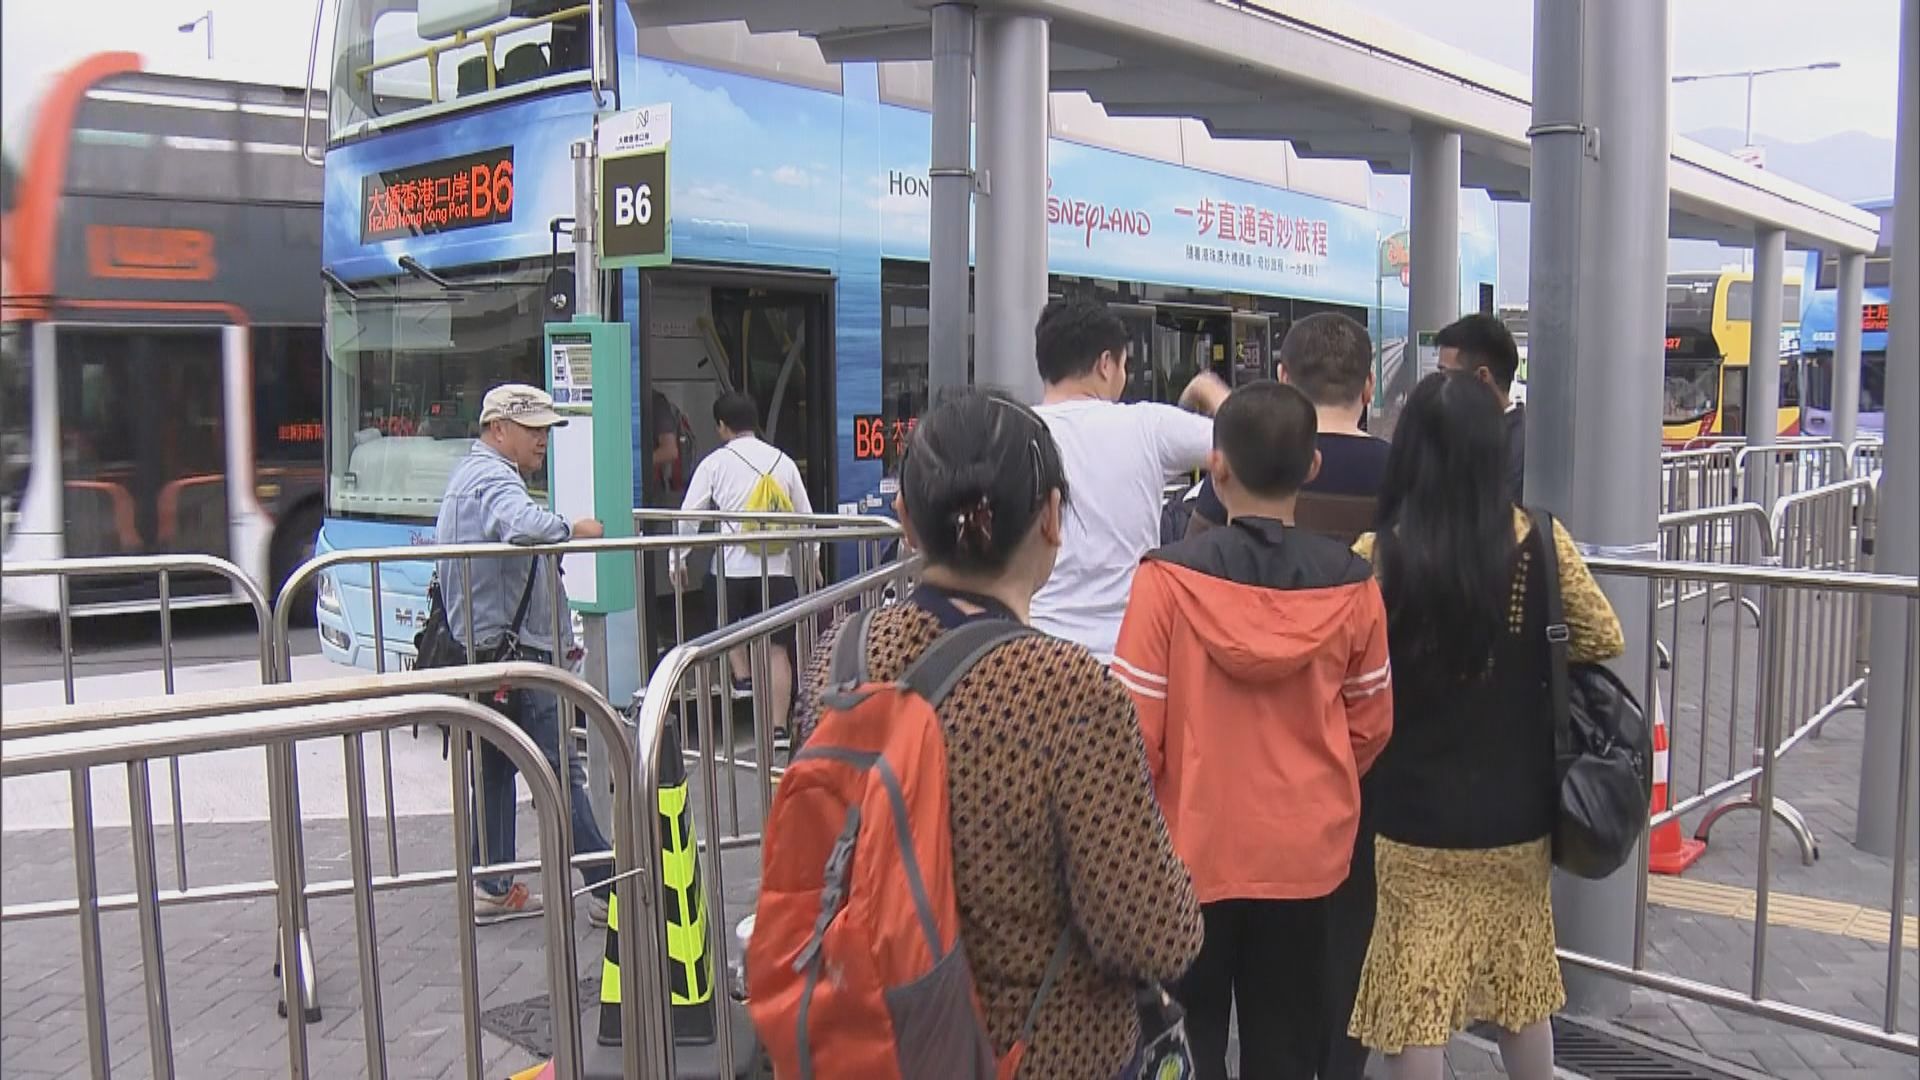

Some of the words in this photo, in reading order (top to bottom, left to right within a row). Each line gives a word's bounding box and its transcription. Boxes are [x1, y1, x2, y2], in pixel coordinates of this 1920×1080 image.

[368, 170, 470, 216] 大橋香港口岸
[471, 160, 514, 218] B6
[889, 170, 929, 198] HON
[399, 210, 422, 229] Hong
[423, 206, 448, 225] Kong
[449, 202, 469, 219] Port
[615, 184, 651, 226] B6
[1048, 198, 1151, 248] SNEYLAND
[1174, 198, 1328, 257] 一步直通奇妙旅程
[1862, 305, 1889, 319] 士尼
[856, 417, 885, 458] B6
[395, 607, 428, 629] MA
